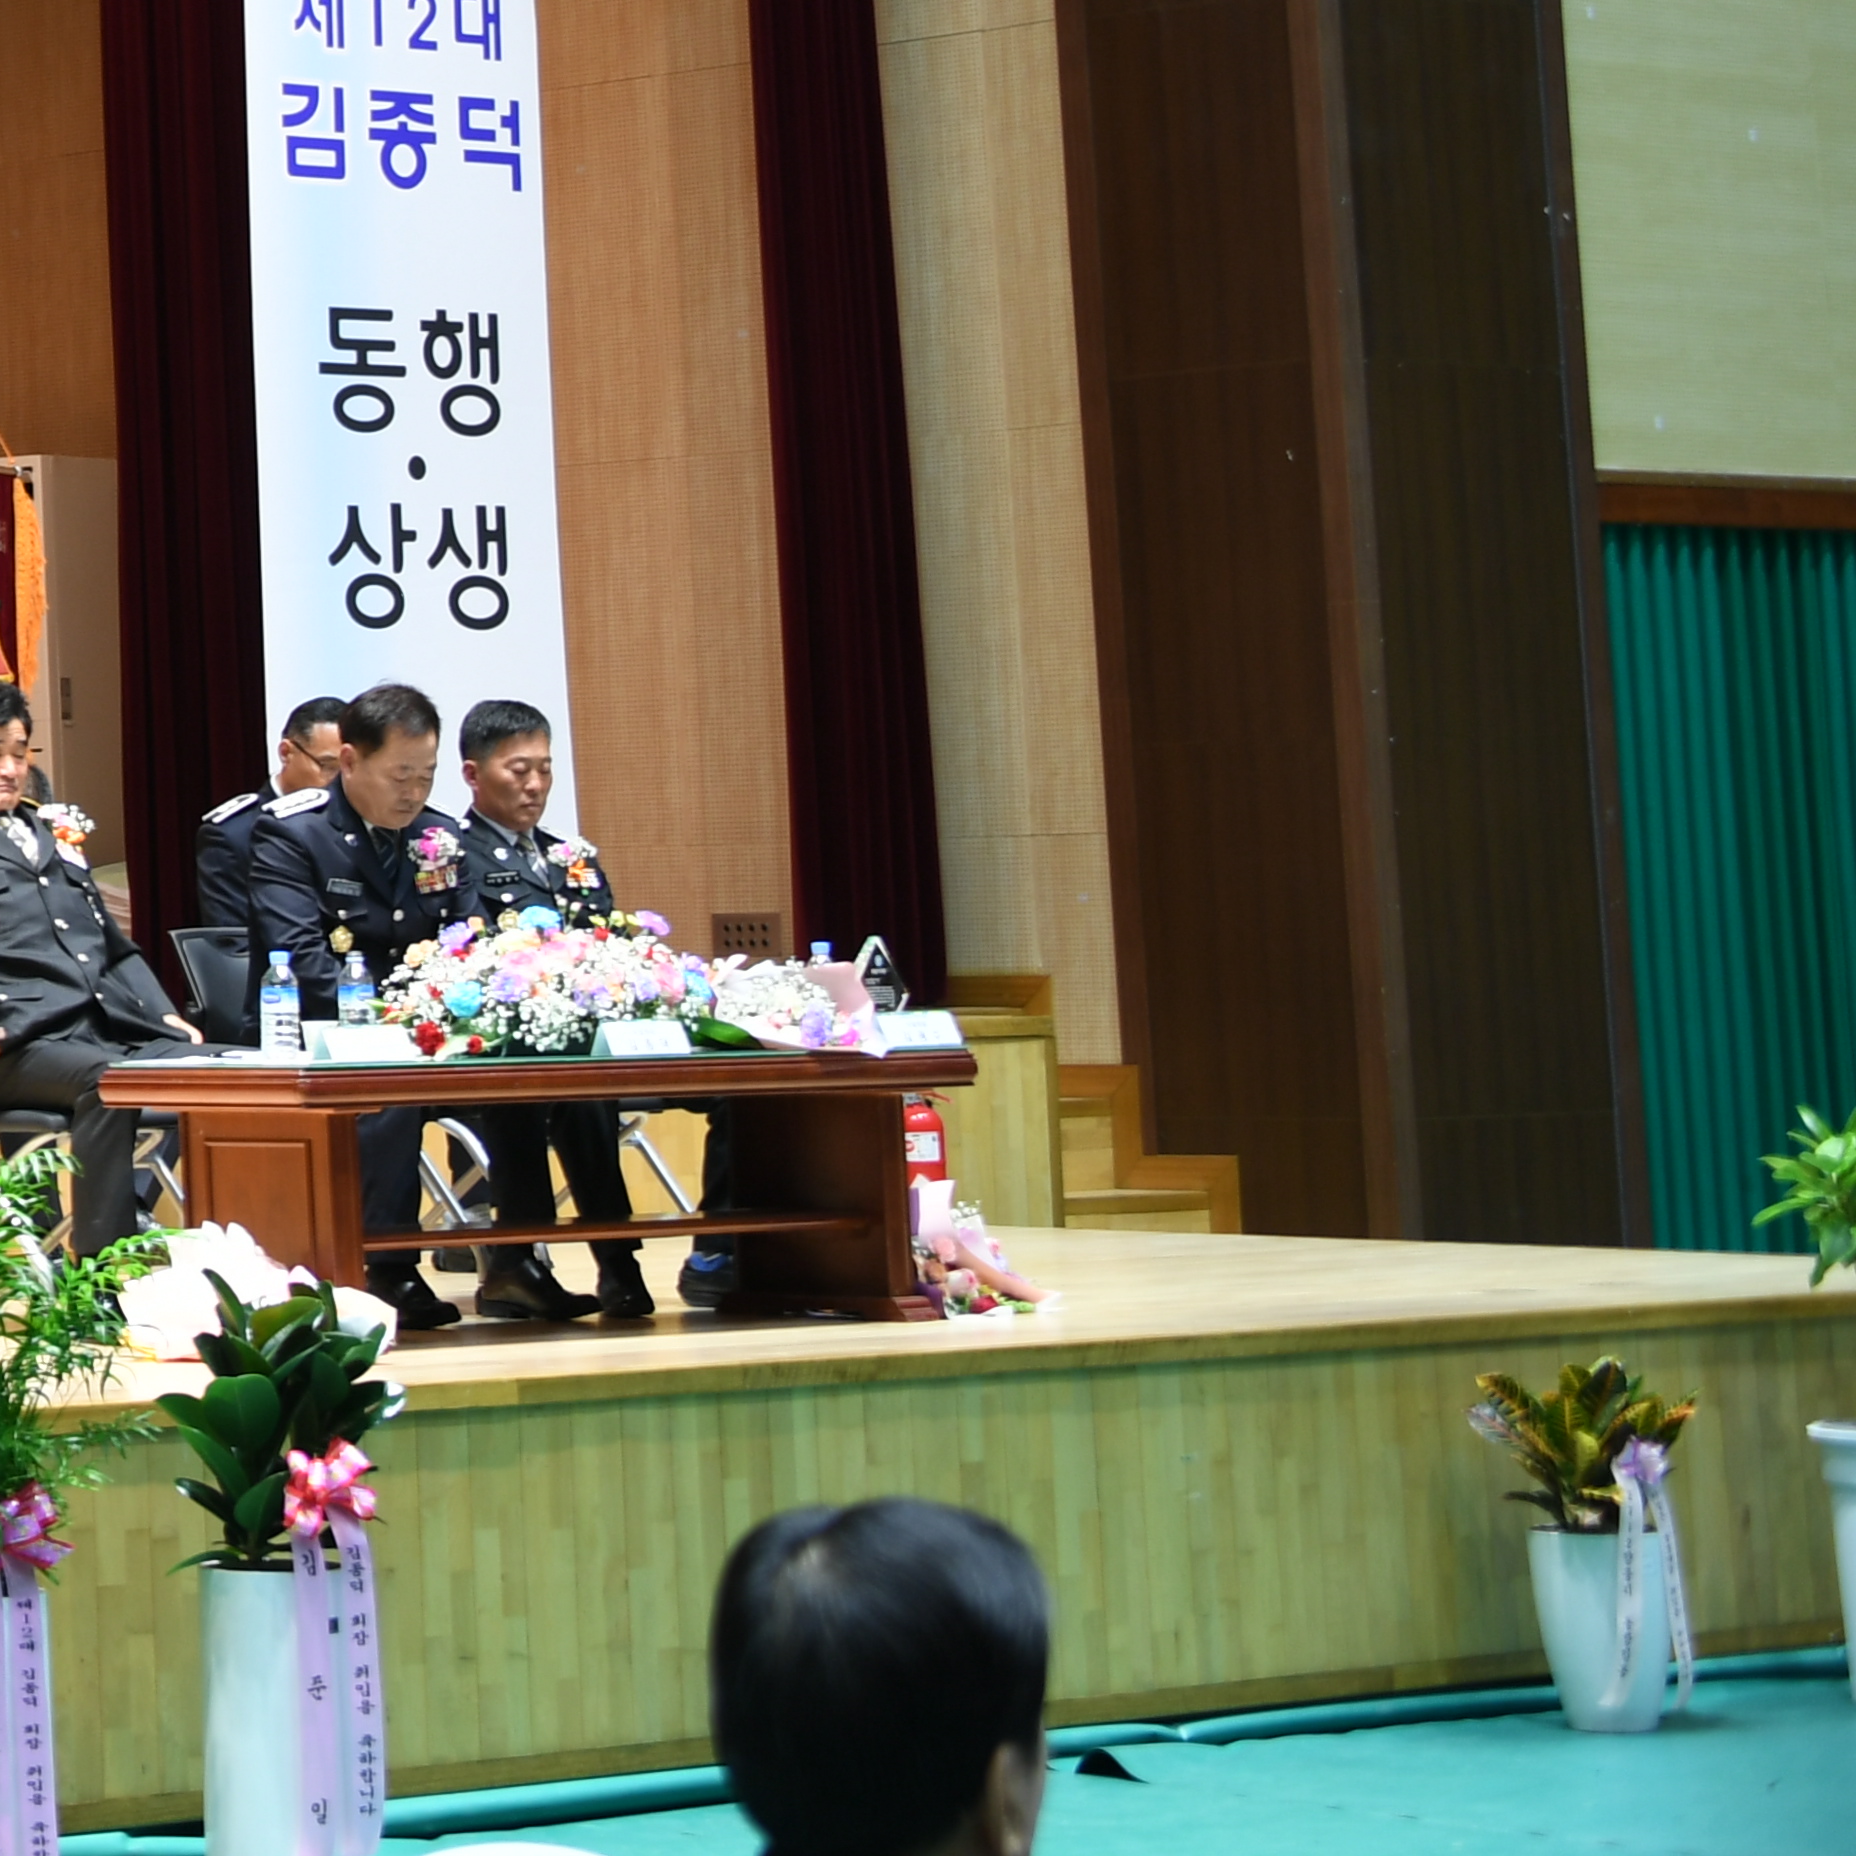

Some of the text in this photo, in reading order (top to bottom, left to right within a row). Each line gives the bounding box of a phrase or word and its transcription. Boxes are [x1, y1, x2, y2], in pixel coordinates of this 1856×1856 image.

[281, 82, 523, 192] 김종덕
[317, 305, 502, 437] 동행
[328, 502, 510, 631] 상생
